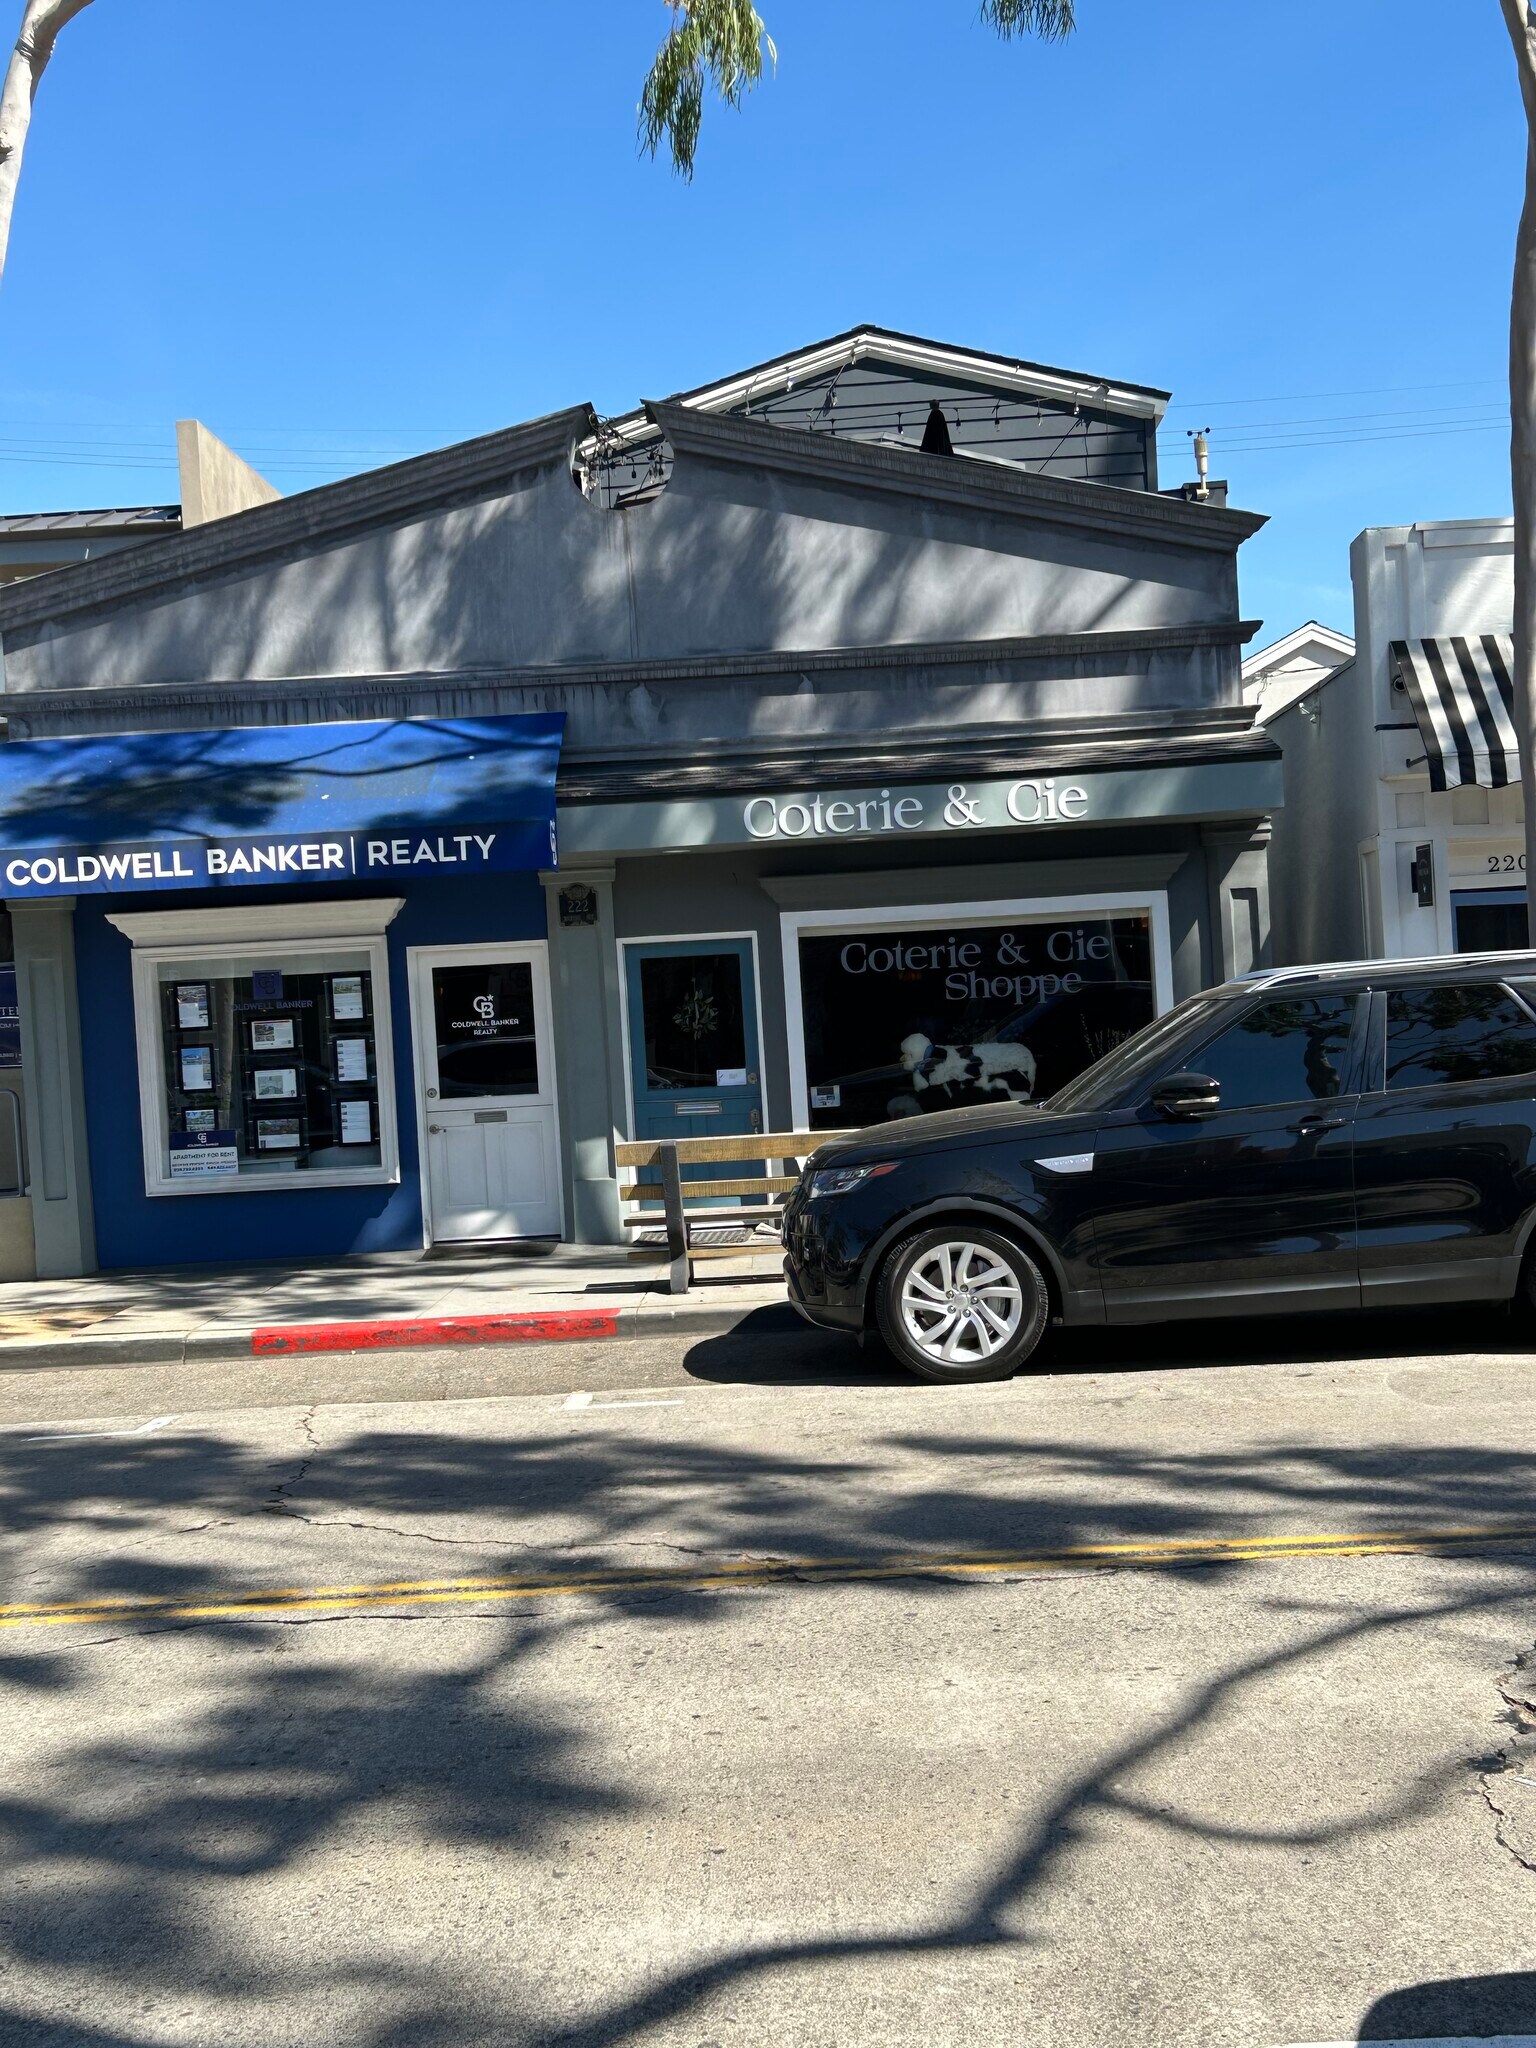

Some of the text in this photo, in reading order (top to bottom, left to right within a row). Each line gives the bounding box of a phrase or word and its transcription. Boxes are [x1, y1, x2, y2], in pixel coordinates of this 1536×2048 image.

[743, 778, 1089, 839] Coterie & Cie
[5, 834, 496, 886] COLDWELL BANKER REALTY
[1488, 854, 1527, 873] 220
[568, 900, 589, 913] 222
[840, 929, 1111, 974] Coterie & Cie
[945, 970, 1083, 1006] Shoppe
[276, 1000, 313, 1009] BANKER
[451, 1018, 519, 1029] COLDWELL BANKER
[473, 1028, 498, 1036] REALTY
